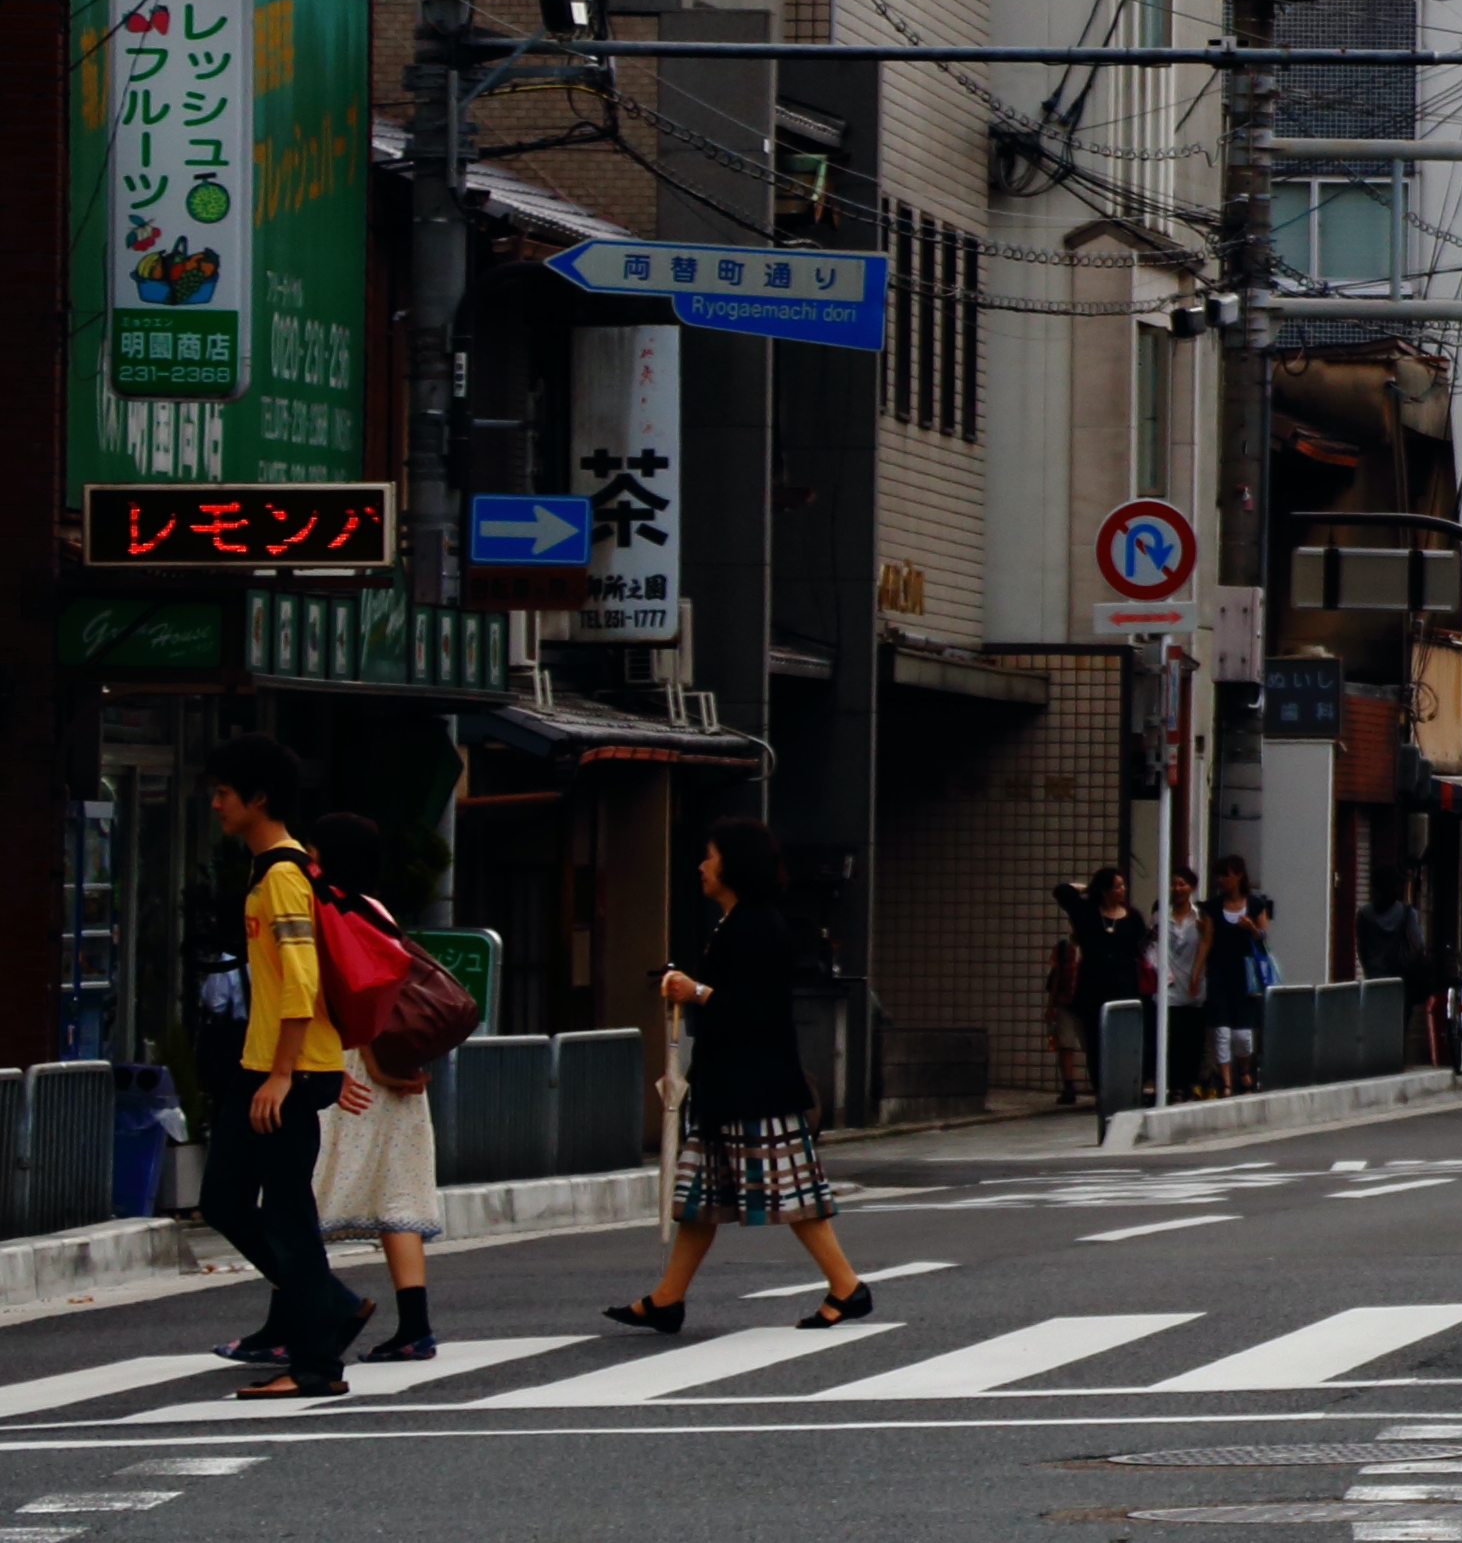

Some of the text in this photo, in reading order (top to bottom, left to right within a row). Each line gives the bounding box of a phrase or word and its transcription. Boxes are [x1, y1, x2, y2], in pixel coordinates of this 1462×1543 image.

[122, 48, 169, 210] フルーツ
[623, 253, 837, 290] 両替町通り
[691, 295, 857, 323] Ryogaemachi dori
[118, 365, 231, 384] 231-2368
[576, 449, 669, 547] 茶
[579, 610, 667, 630] TEL 231-1777
